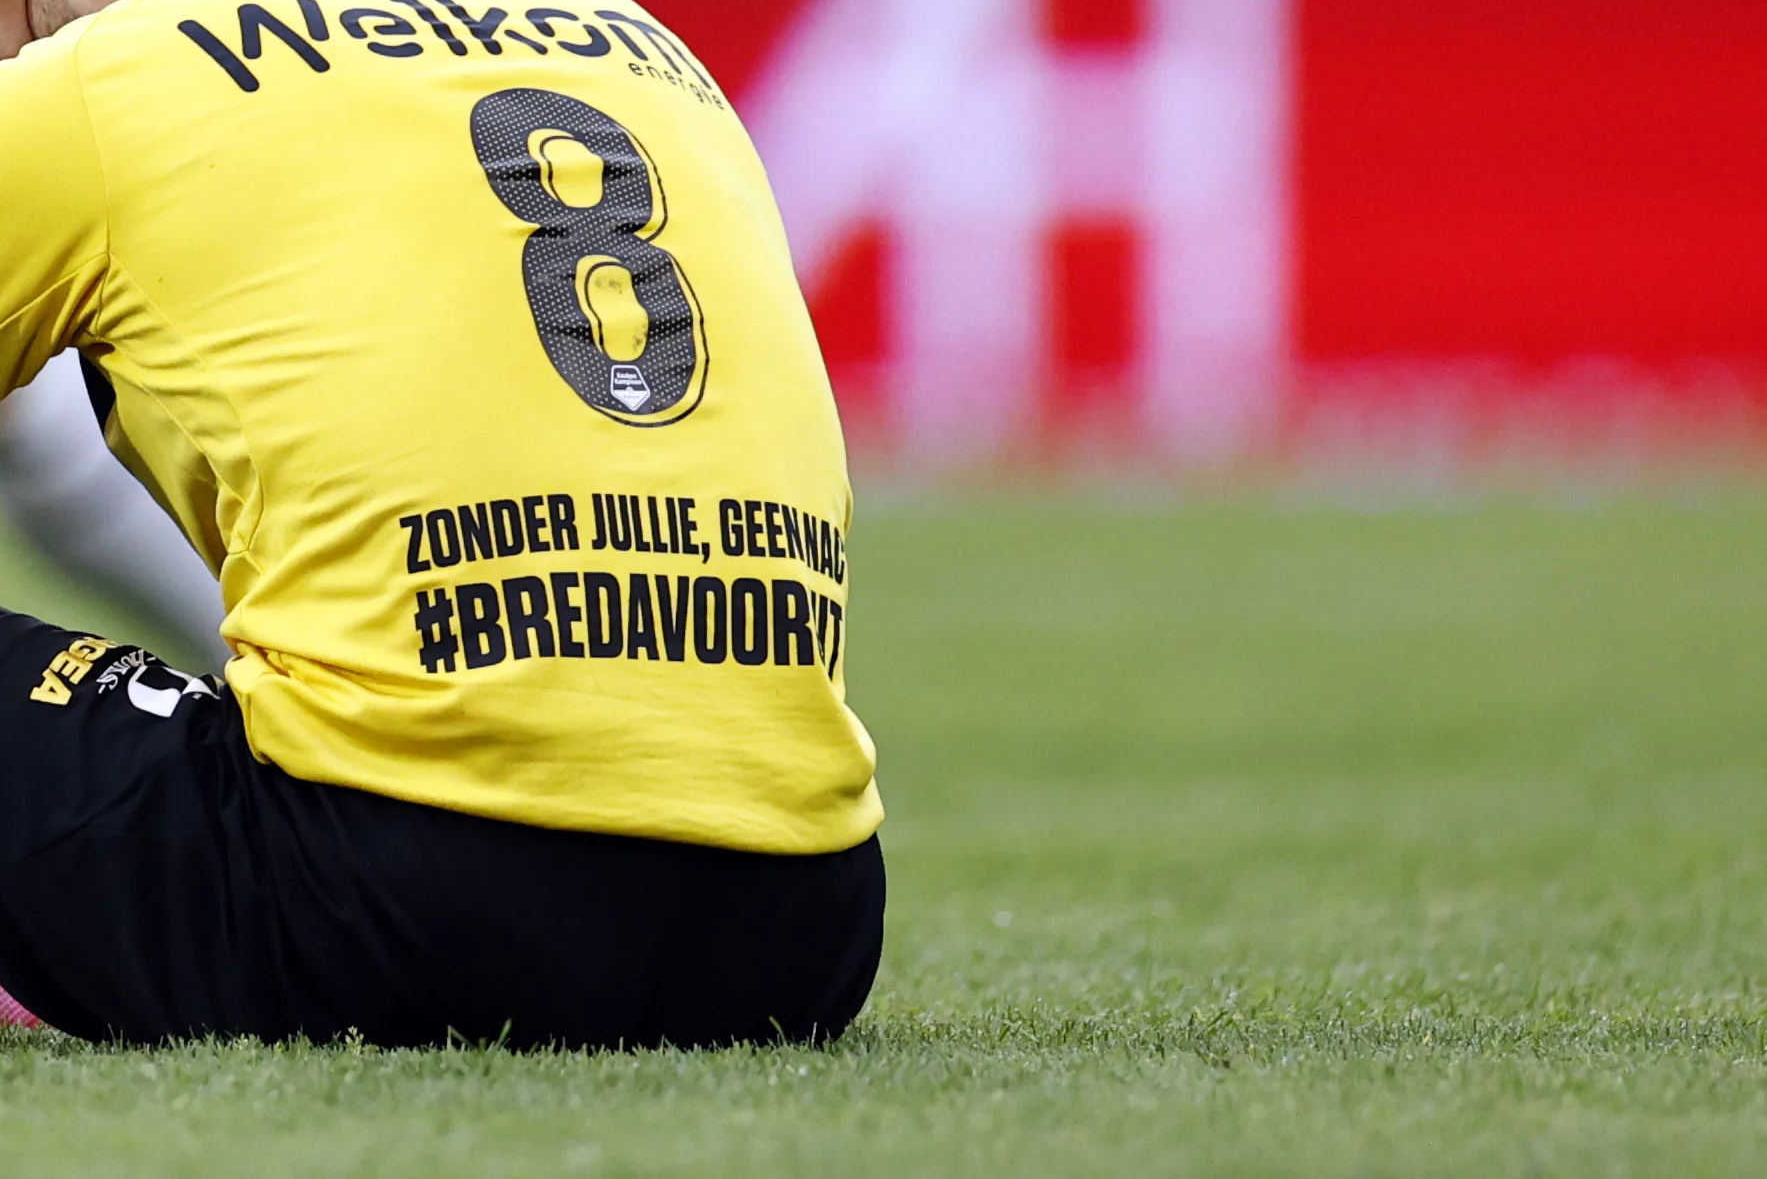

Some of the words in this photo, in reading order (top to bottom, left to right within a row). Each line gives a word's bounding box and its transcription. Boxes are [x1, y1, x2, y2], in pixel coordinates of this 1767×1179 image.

[628, 62, 725, 110] energie
[470, 87, 709, 428] 8
[399, 493, 580, 574] ZONDER
[591, 493, 710, 564] JULLIE,
